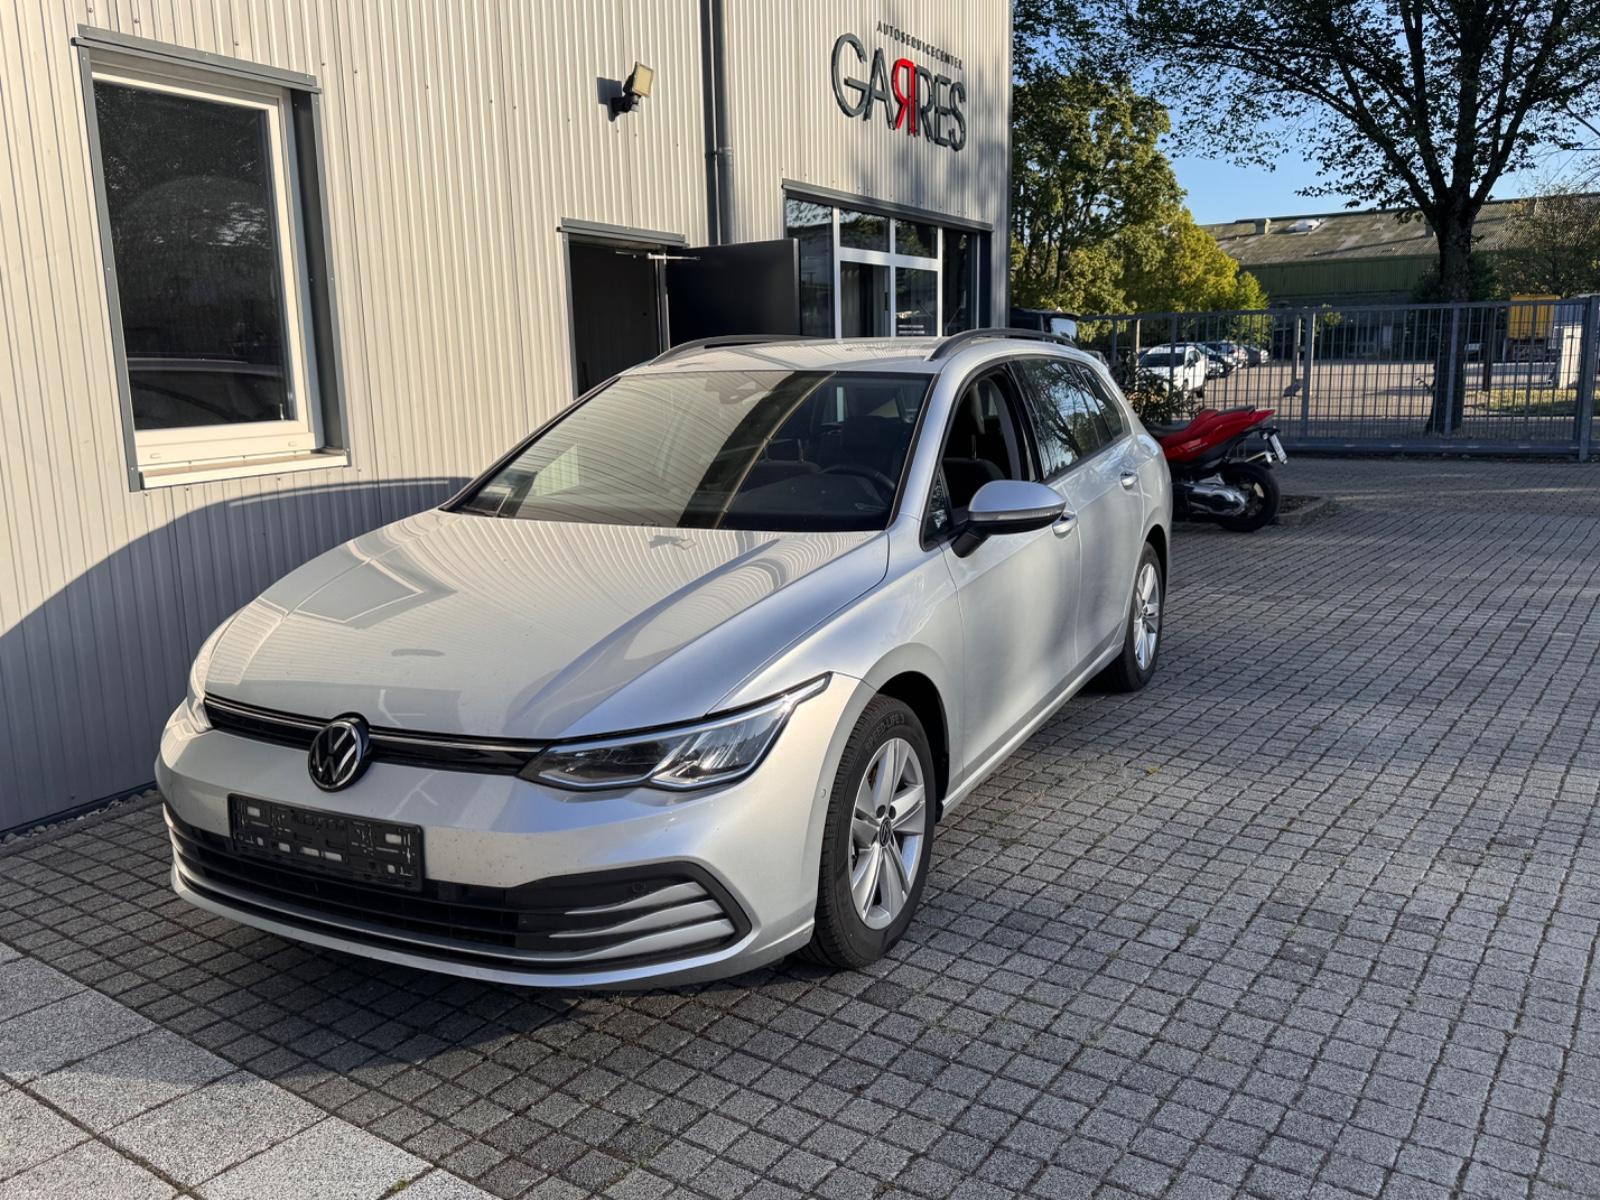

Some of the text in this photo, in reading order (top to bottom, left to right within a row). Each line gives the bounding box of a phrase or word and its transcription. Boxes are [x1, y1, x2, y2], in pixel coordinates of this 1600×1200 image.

[877, 21, 963, 70] AUTOSERVICECENTER
[831, 33, 966, 151] GARRES
[312, 722, 361, 788] VW
